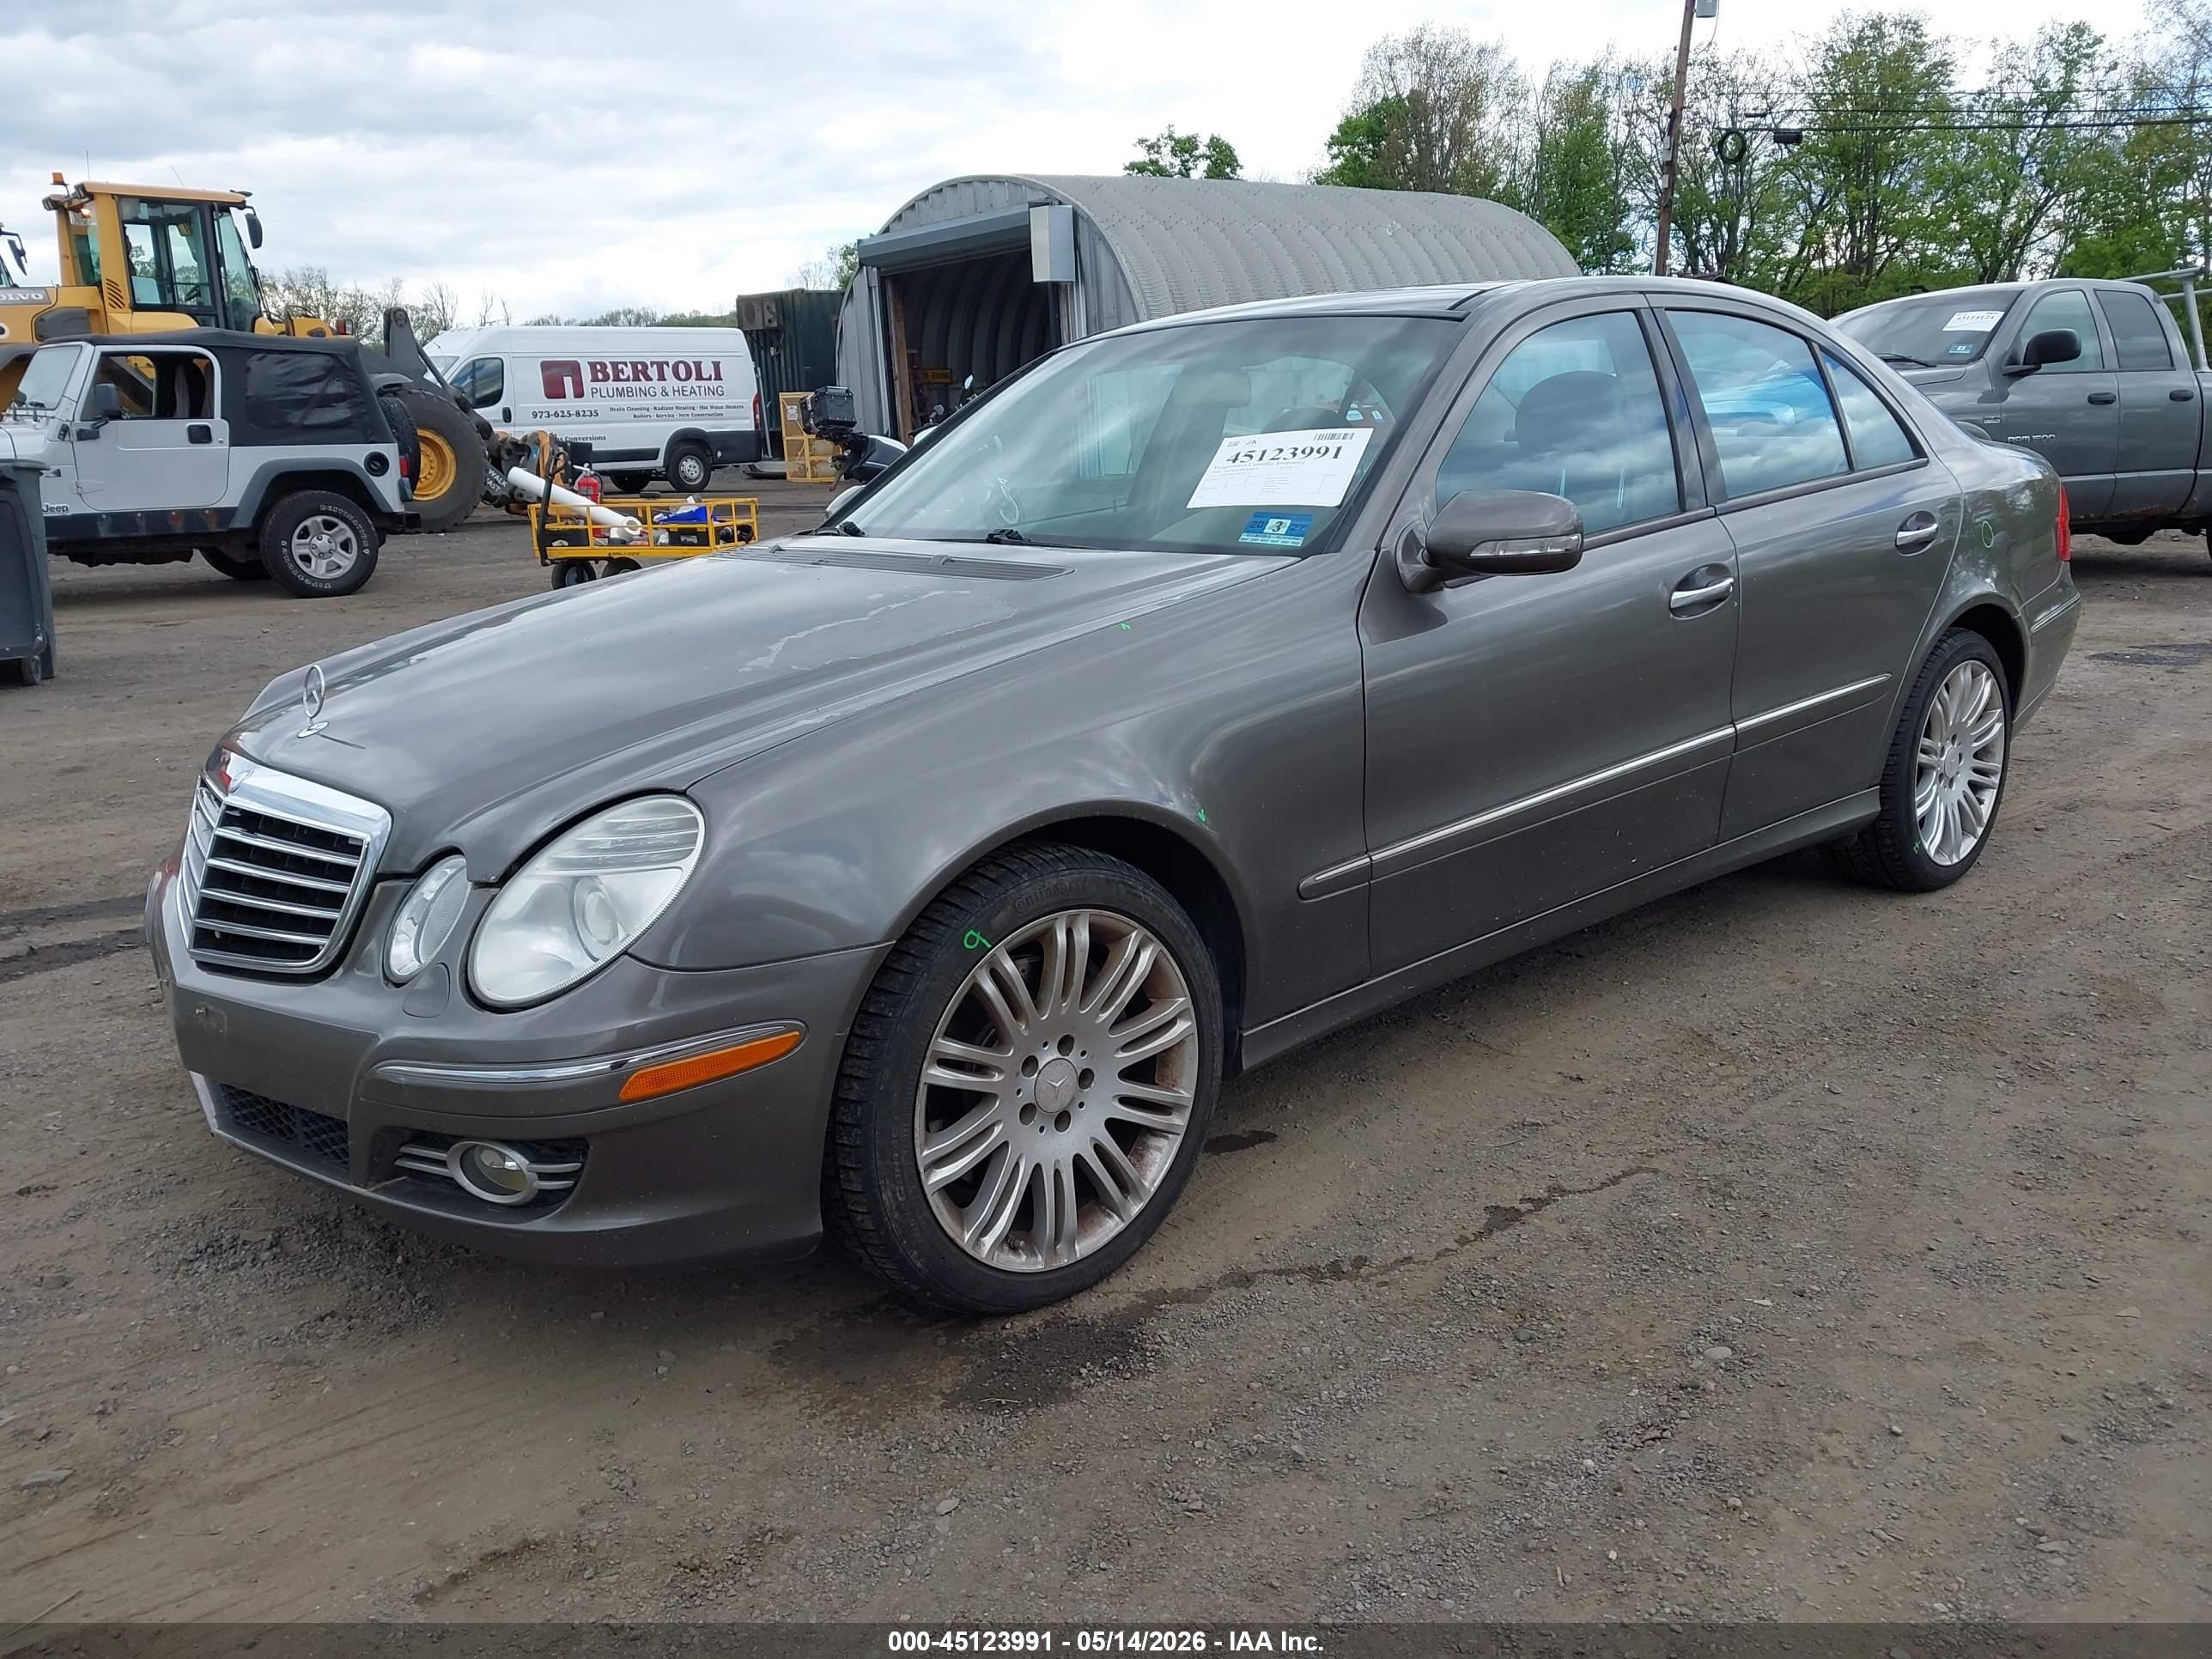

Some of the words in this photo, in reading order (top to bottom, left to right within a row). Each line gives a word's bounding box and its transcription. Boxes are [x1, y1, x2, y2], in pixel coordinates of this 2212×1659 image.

[587, 360, 724, 383] BERTOLI
[591, 386, 657, 398] PLUMBING
[660, 386, 670, 398] &
[672, 385, 725, 398] HEATING
[532, 410, 599, 420] 973-625-8235
[1226, 446, 1343, 464] 45123991
[489, 468, 507, 488] WALK
[41, 503, 69, 514] Jeep
[1250, 520, 1265, 529] 20
[1271, 520, 1284, 532] 3
